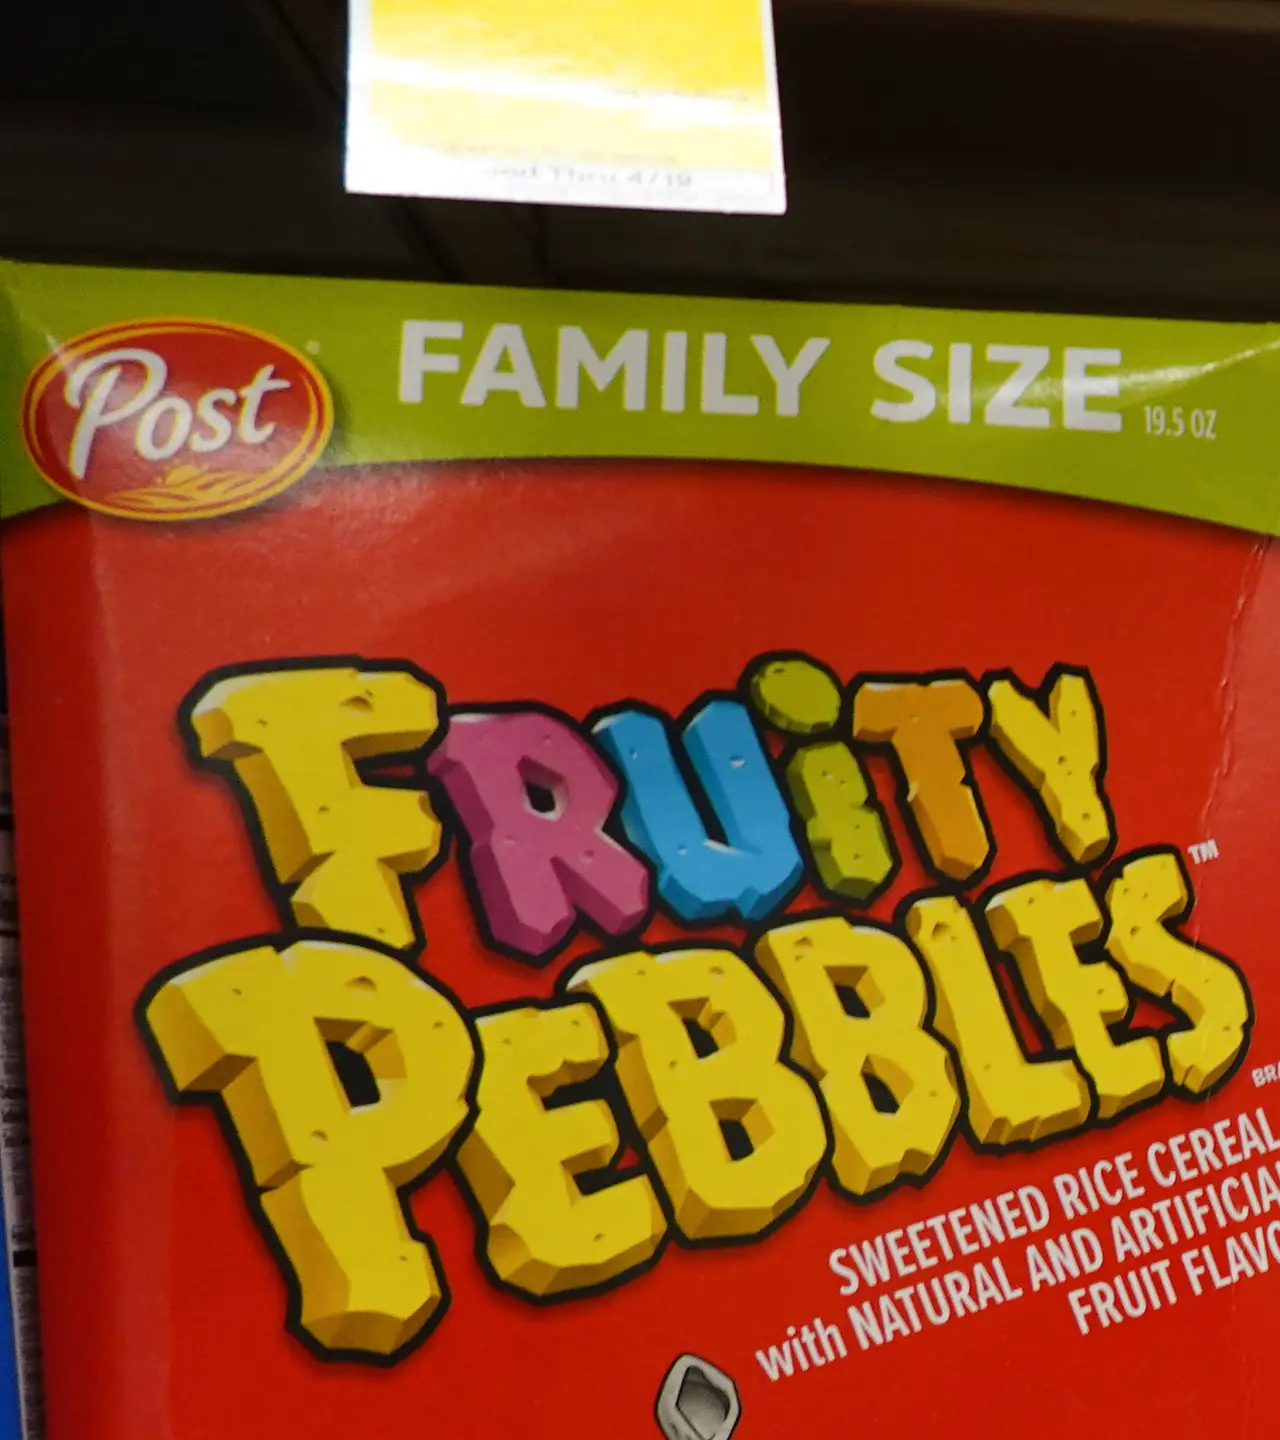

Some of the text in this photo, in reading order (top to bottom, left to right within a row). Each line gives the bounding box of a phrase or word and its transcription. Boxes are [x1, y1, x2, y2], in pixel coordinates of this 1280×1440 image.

[65, 348, 290, 480] Post
[399, 319, 1217, 440] FAMILY SIZE 19.5 OZ
[137, 846, 1254, 1367] PEBBLES
[829, 1186, 1049, 1296] SWEETENED
[1053, 1153, 1145, 1220] RICE
[755, 1316, 848, 1382] with
[847, 1256, 1023, 1352] NATURAL
[1025, 1227, 1104, 1293] AND
[1067, 1258, 1177, 1336] FRUIT
